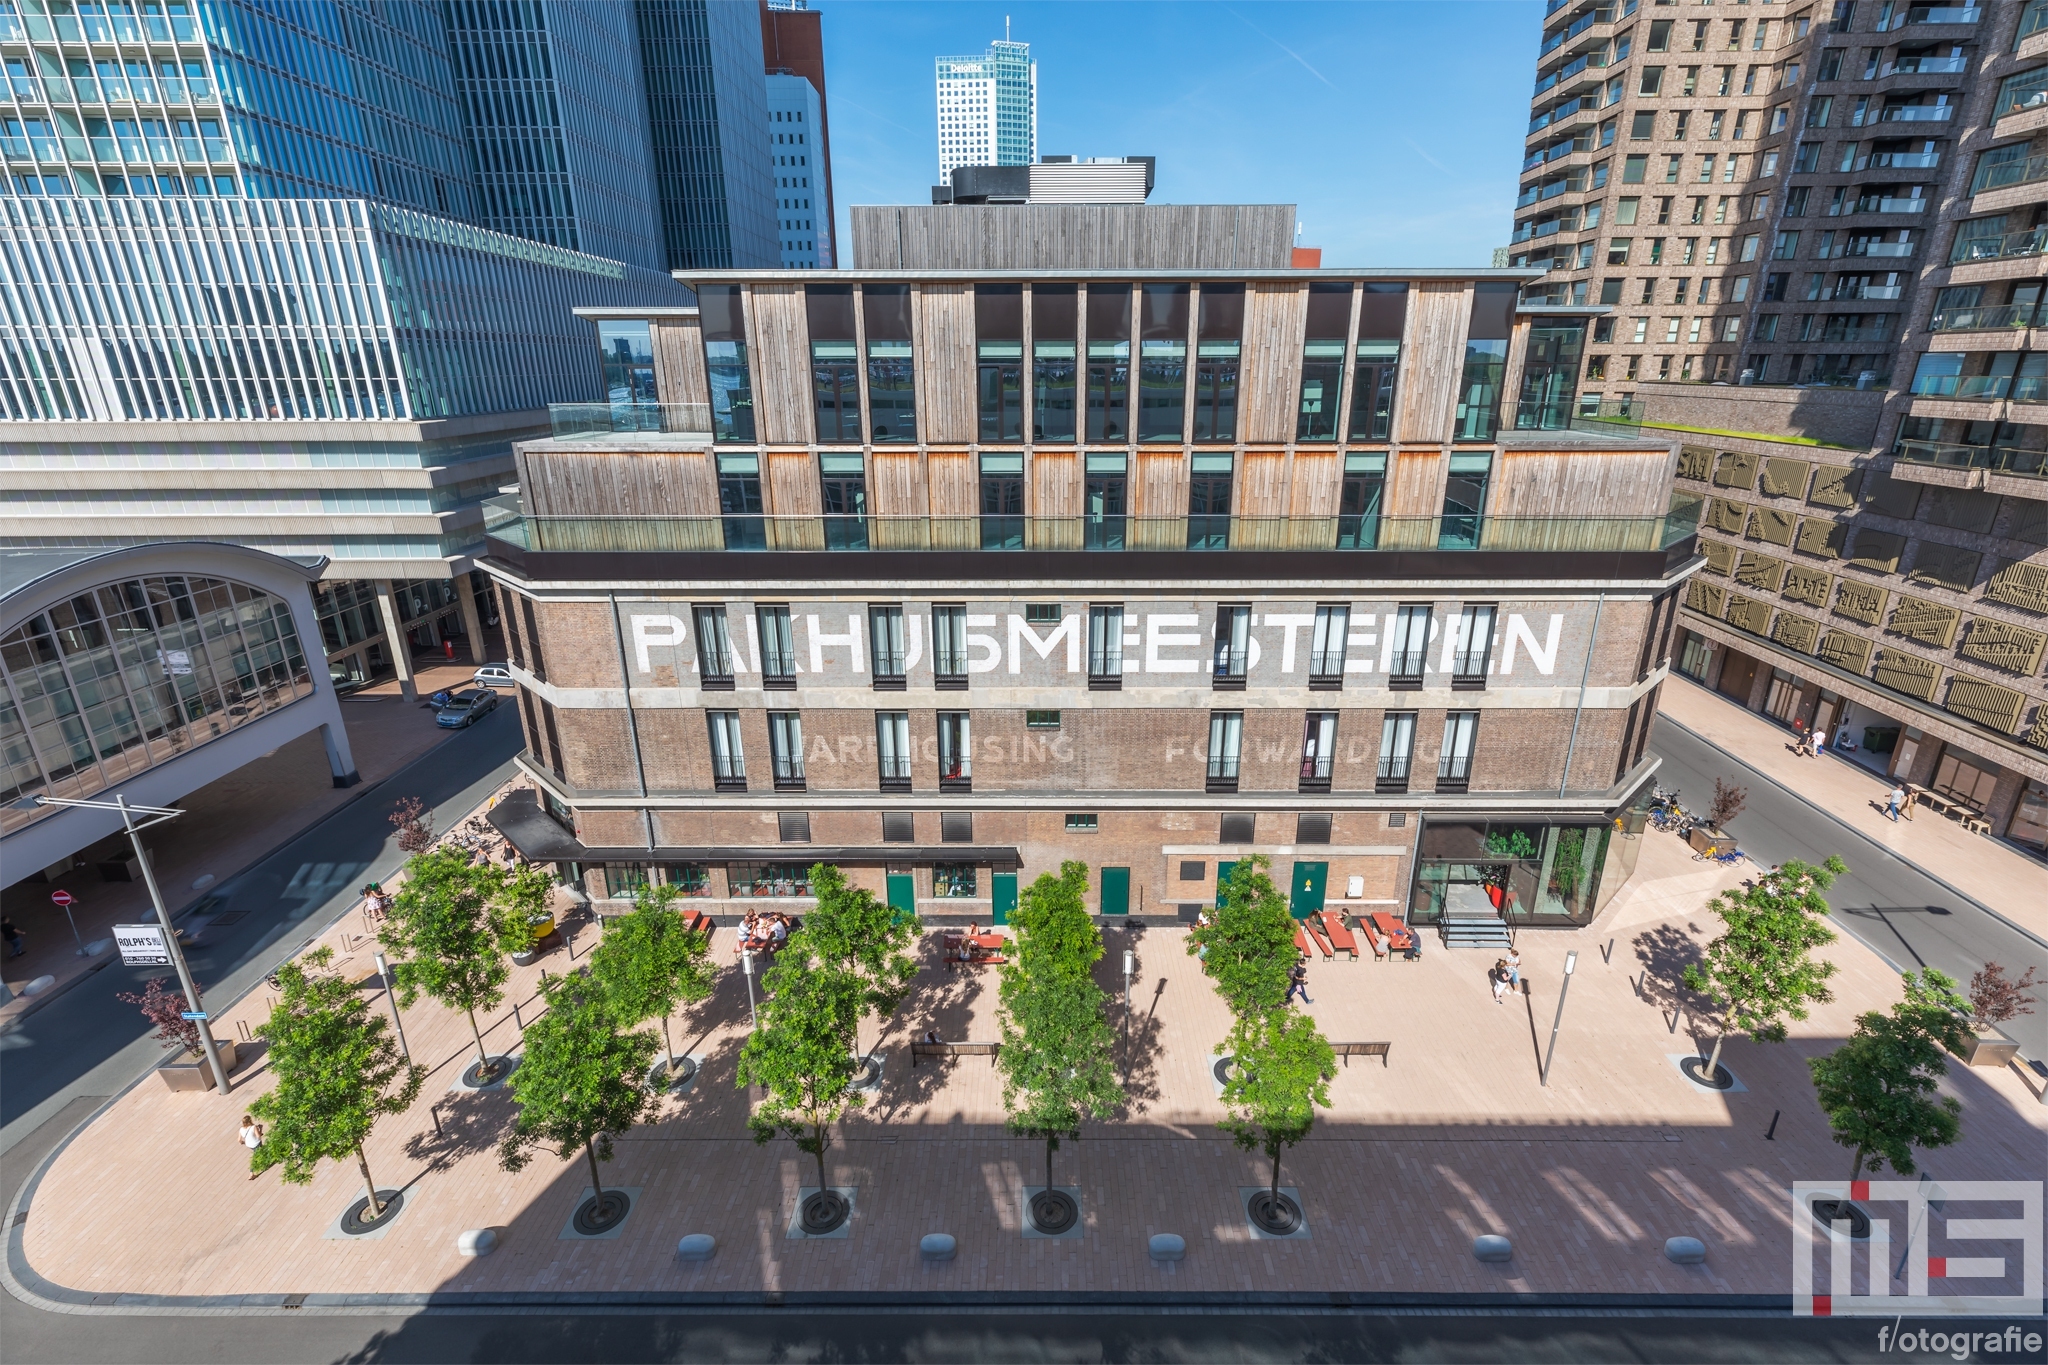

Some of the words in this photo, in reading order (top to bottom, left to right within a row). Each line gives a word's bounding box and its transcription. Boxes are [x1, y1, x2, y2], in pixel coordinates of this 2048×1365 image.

[951, 64, 982, 73] Deloitte
[444, 587, 451, 602] P
[414, 599, 422, 615] P
[118, 937, 152, 947] ROLPH'S
